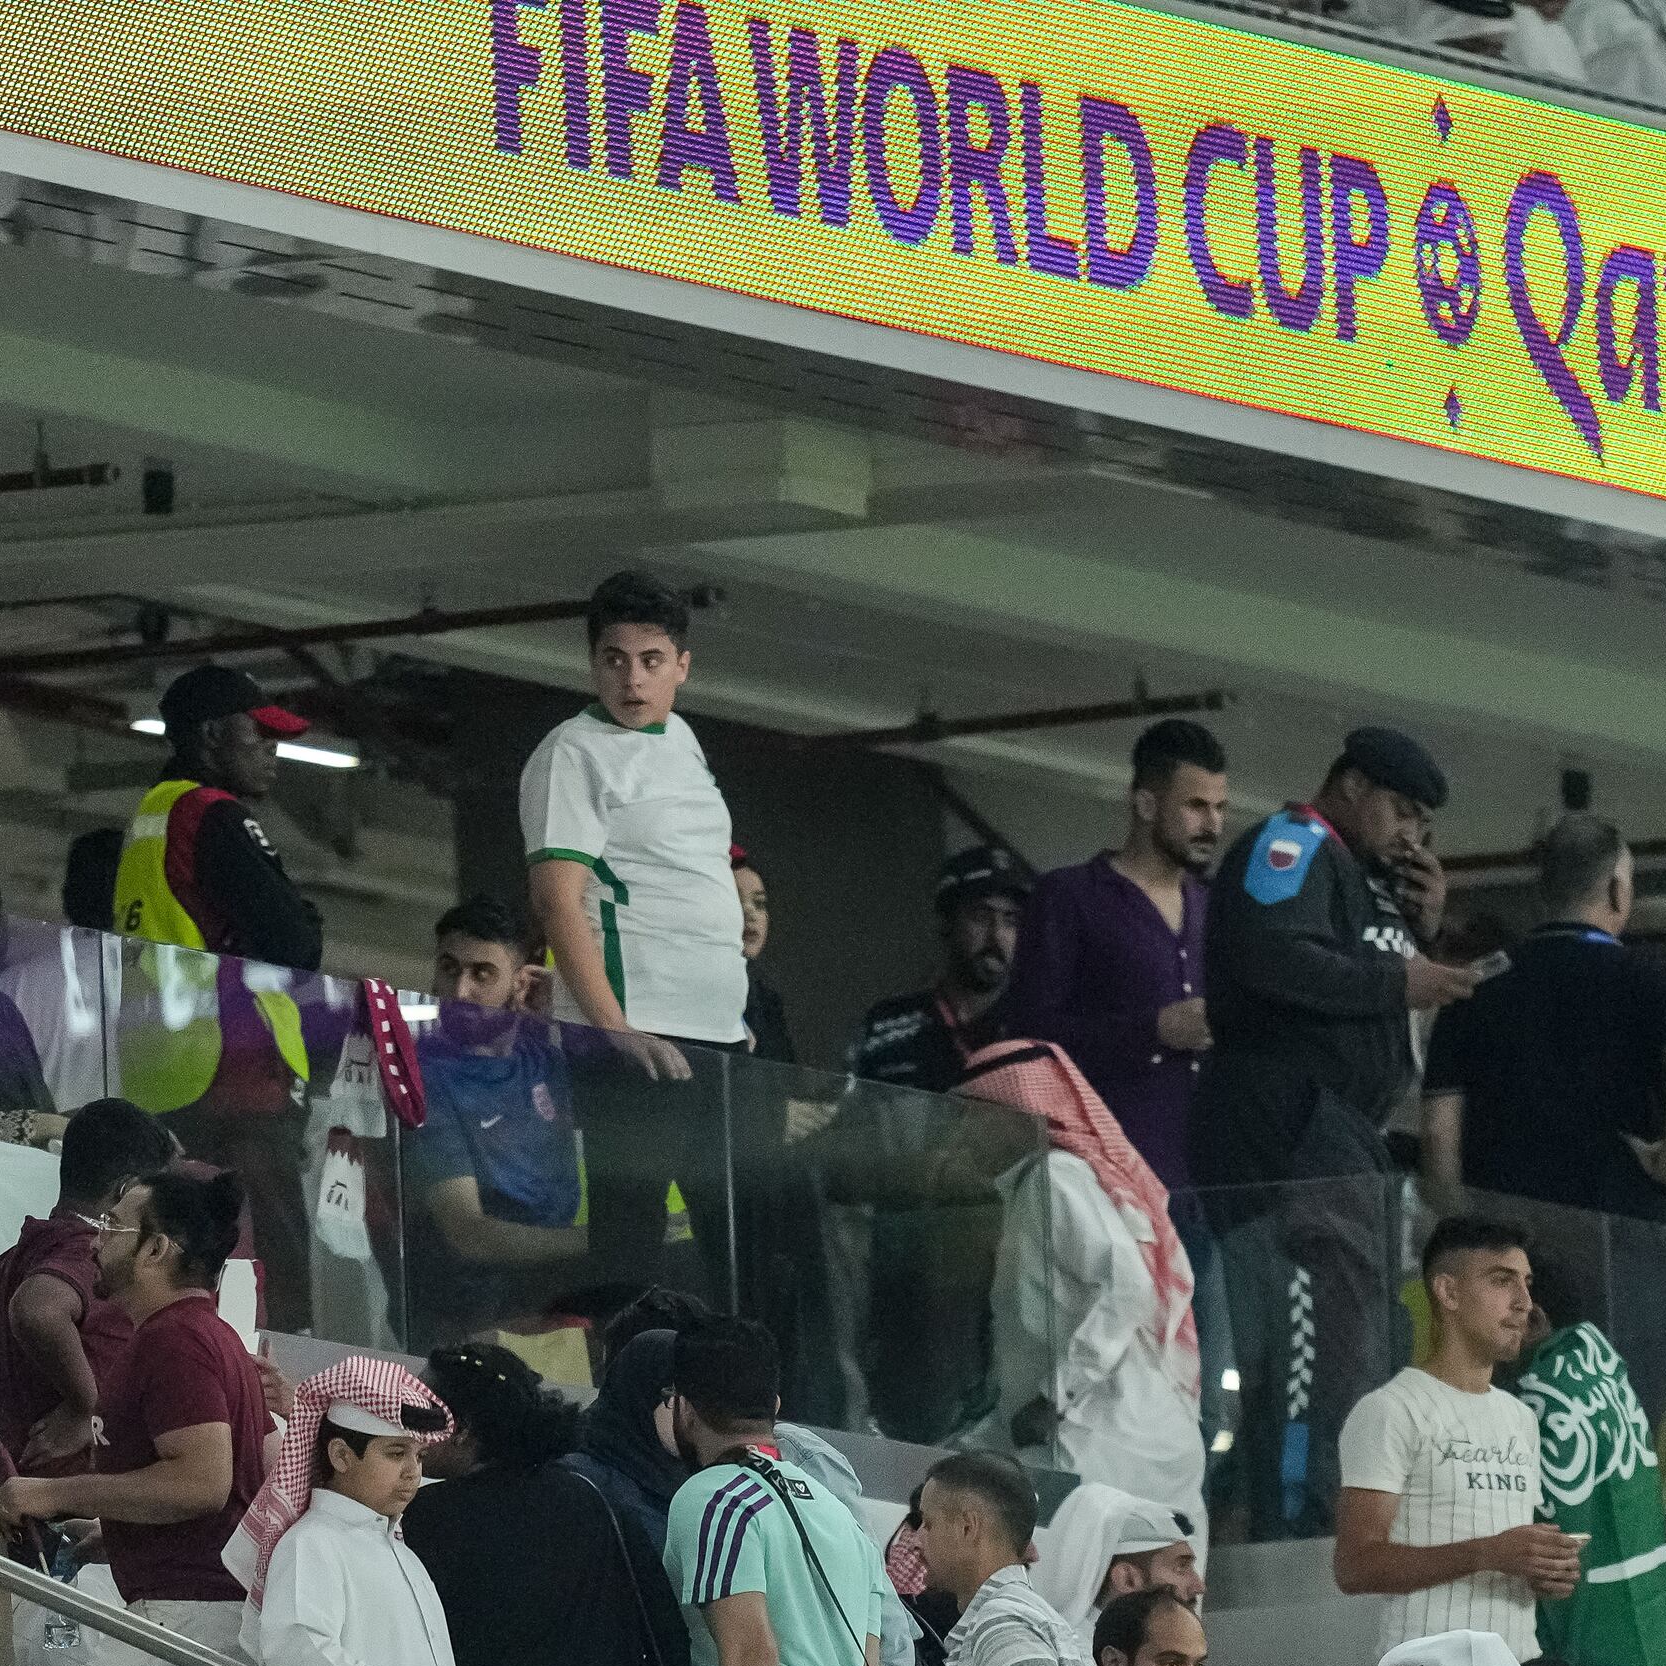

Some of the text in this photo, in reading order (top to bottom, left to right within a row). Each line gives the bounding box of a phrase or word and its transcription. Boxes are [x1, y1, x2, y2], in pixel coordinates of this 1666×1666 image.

[490, 0, 741, 205] FIFA
[749, 19, 1157, 290] WORLD
[1183, 122, 1390, 343] CUP
[1466, 1472, 1527, 1492] KING
